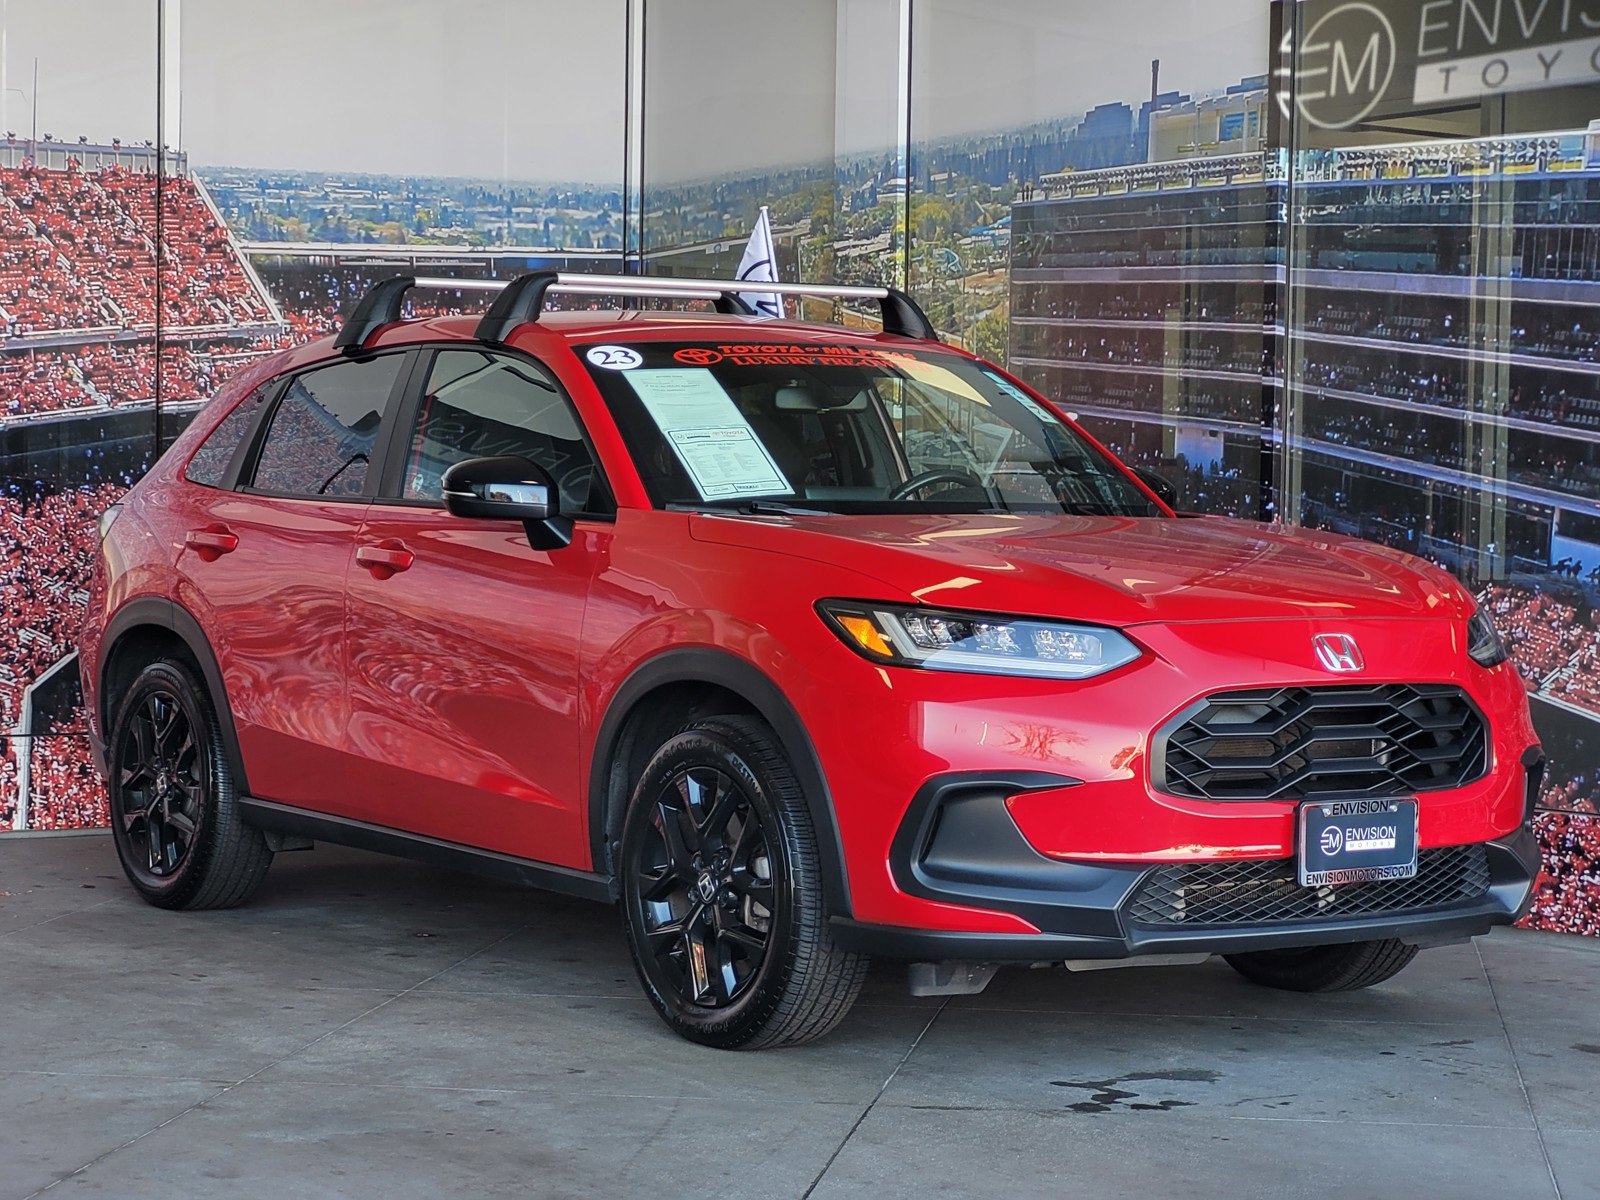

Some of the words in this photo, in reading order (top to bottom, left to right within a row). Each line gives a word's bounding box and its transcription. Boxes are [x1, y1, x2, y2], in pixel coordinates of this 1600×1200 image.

[1418, 0, 1600, 57] ENVI
[594, 350, 637, 366] 23
[717, 345, 804, 355] TOYOTA
[730, 356, 816, 367] LUXURY
[1331, 800, 1389, 816] ENVISION
[1345, 826, 1397, 841] ENVISION
[1306, 865, 1413, 885] ENVISIONMOTORS.COM
